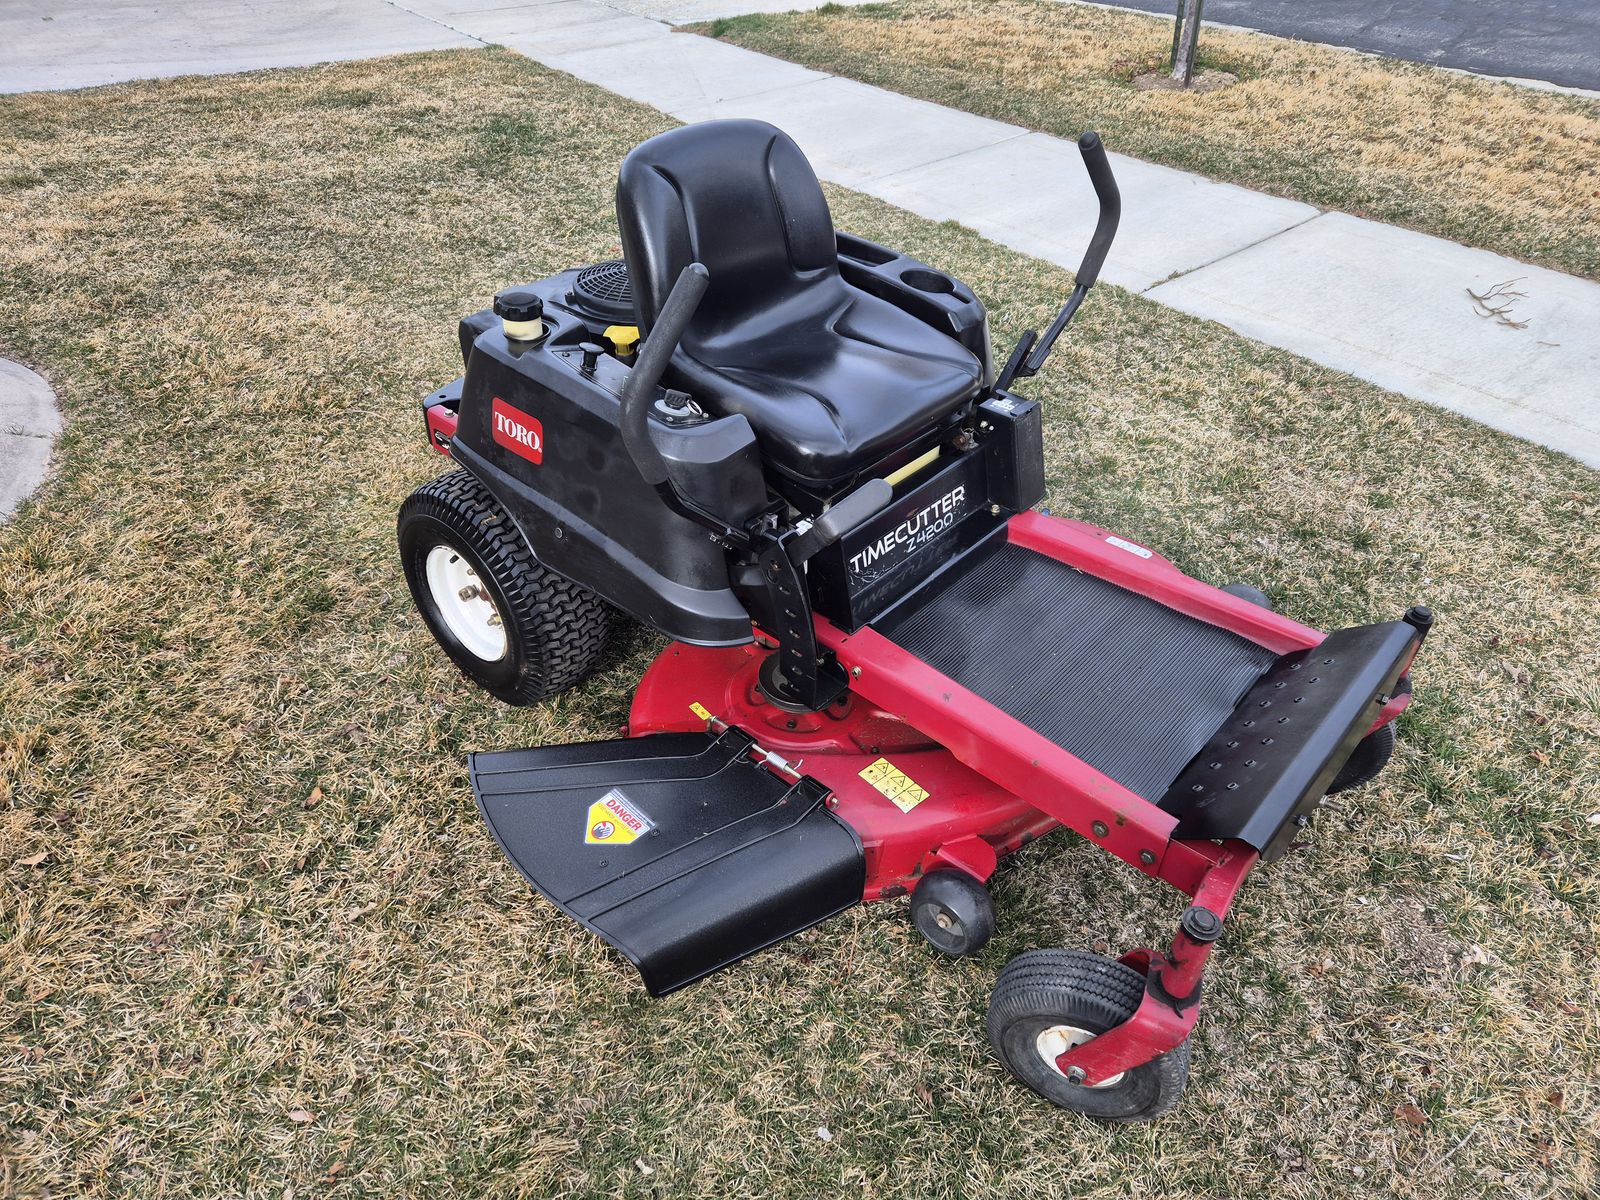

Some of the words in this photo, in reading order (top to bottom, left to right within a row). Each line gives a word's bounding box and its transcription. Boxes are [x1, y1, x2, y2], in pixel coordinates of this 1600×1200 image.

[494, 410, 541, 451] TORO
[849, 484, 966, 573] TIMECUTTER
[905, 512, 953, 553] Z4200
[606, 799, 642, 831] DANGER
